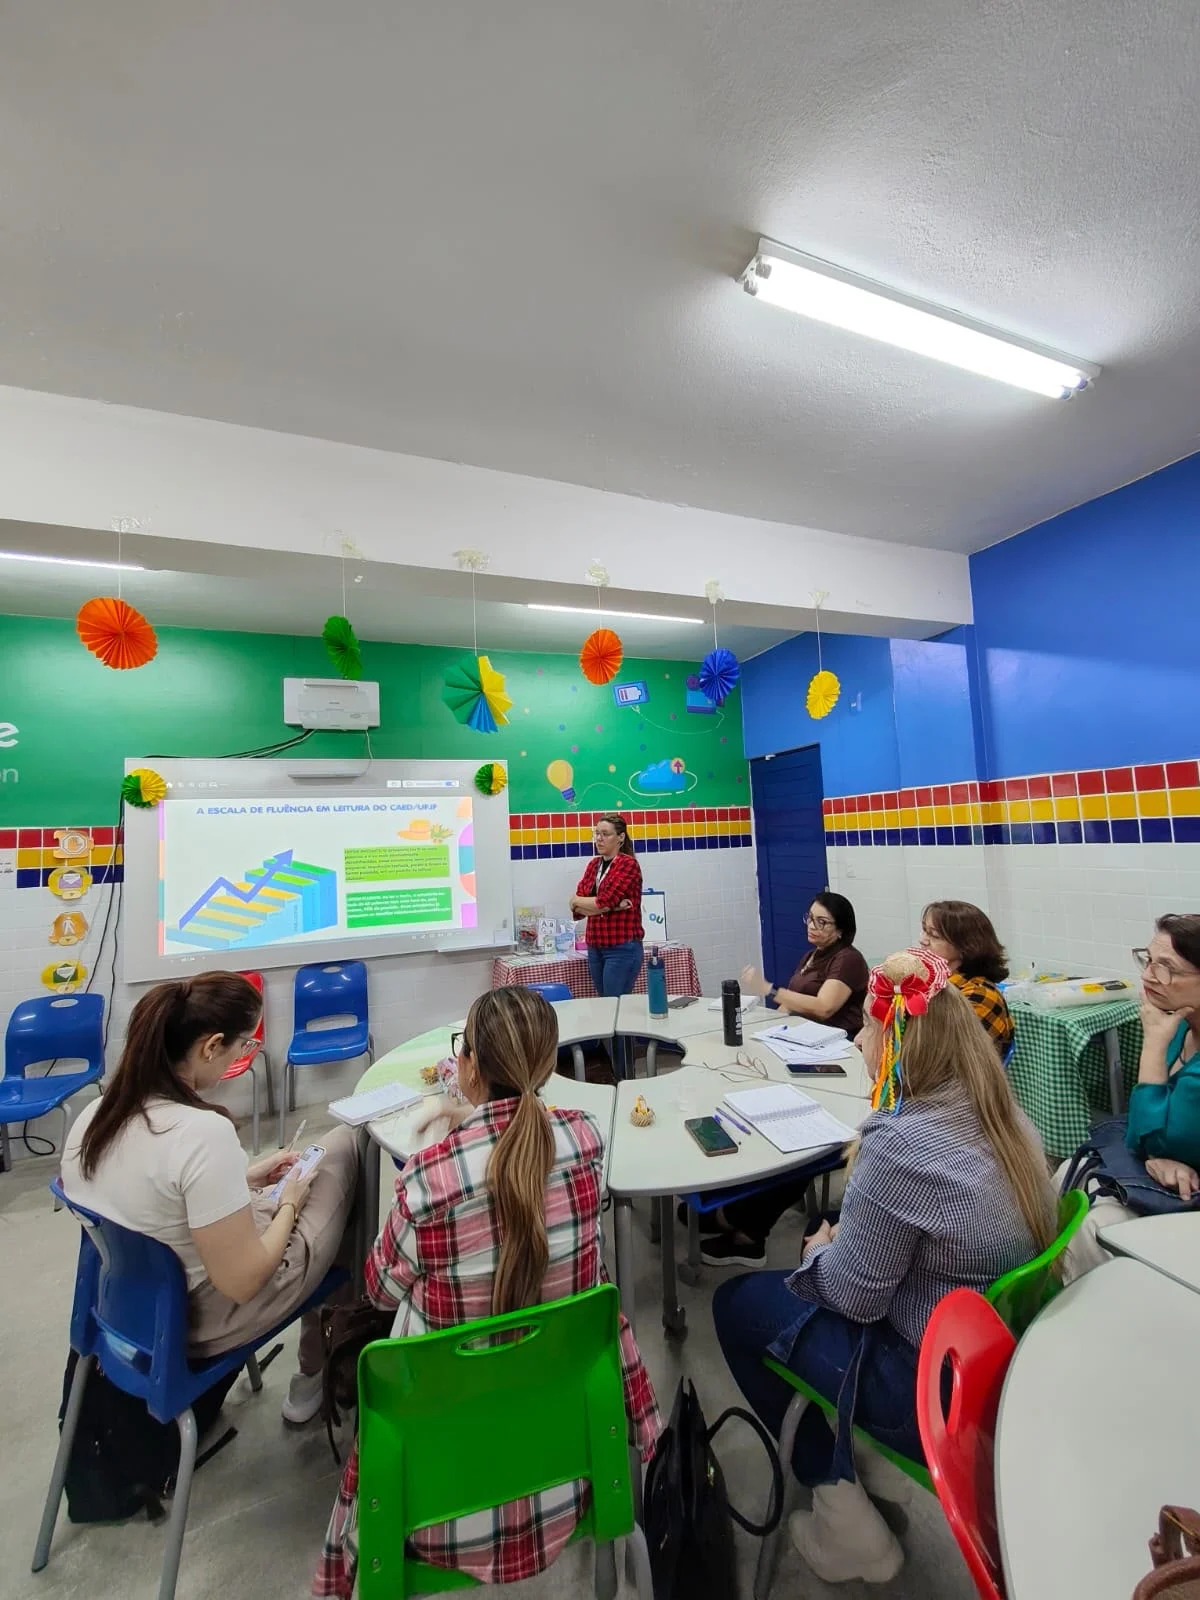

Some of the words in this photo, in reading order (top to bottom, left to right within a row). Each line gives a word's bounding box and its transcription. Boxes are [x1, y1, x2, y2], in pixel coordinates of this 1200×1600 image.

[0, 768, 19, 783] n
[196, 807, 204, 815] A
[207, 806, 247, 815] ESCALA
[250, 806, 264, 814] DE
[266, 803, 313, 814] FLUÊNCIA
[333, 804, 370, 812] LEITURA
